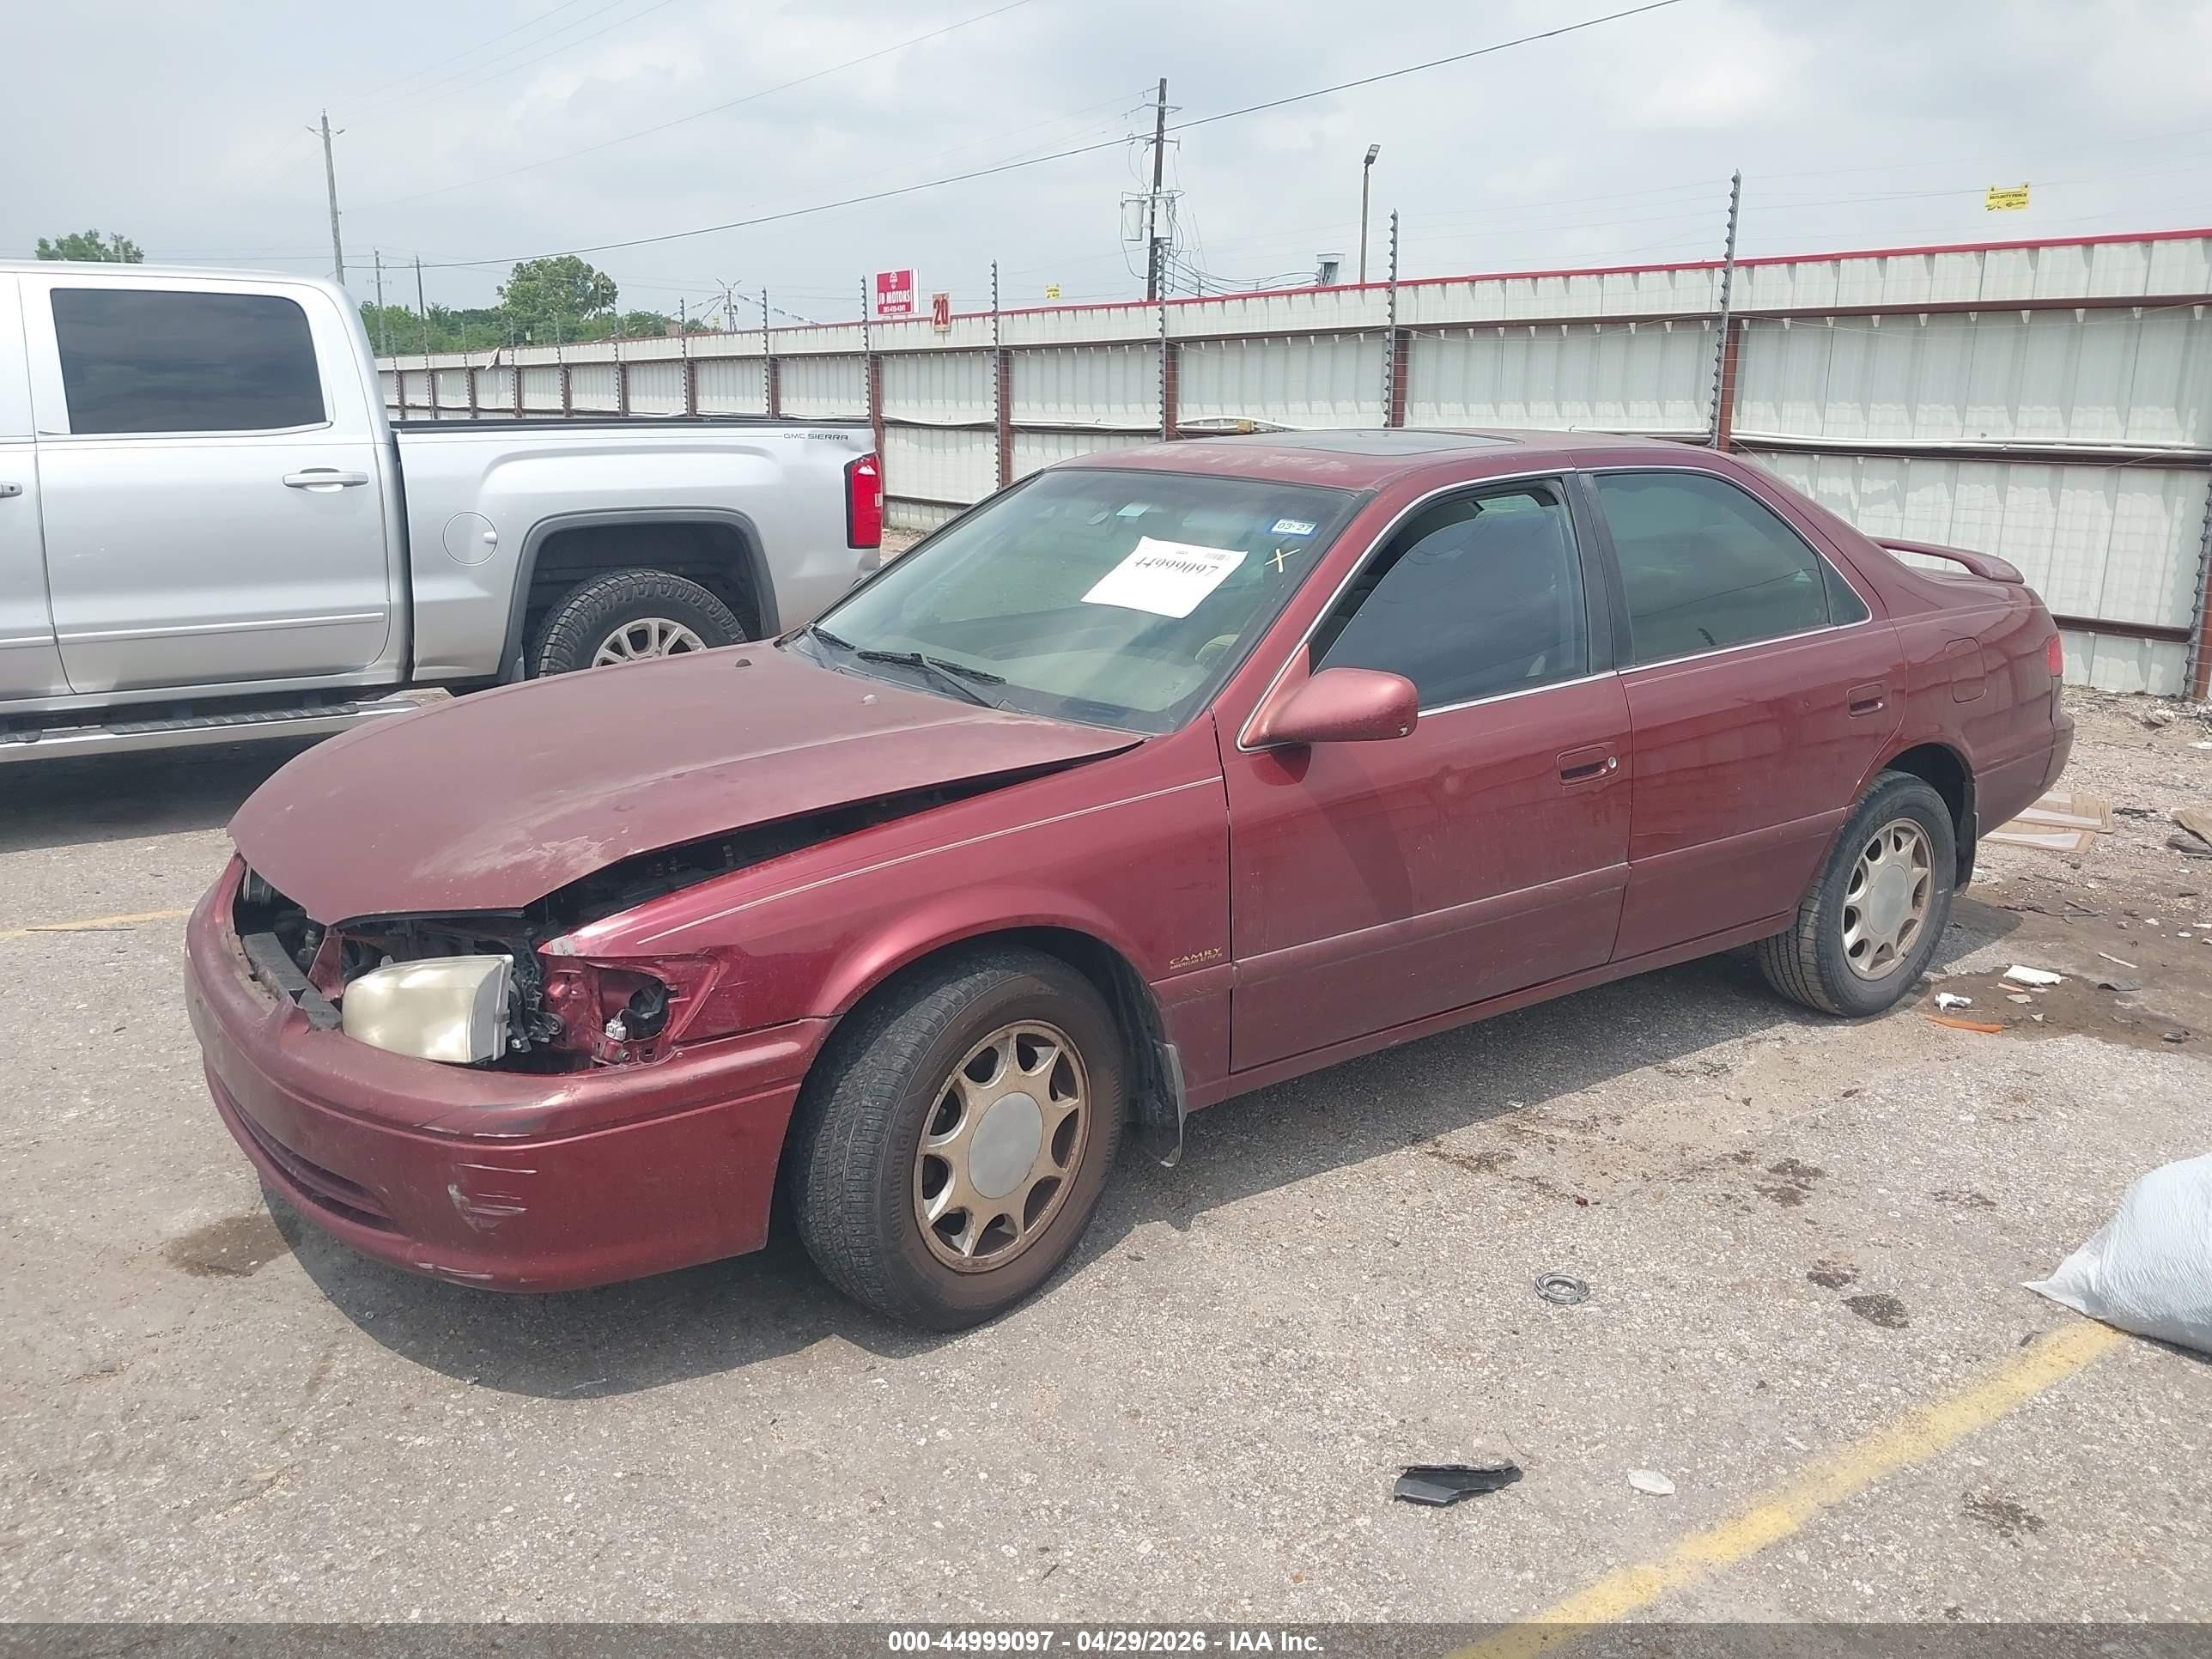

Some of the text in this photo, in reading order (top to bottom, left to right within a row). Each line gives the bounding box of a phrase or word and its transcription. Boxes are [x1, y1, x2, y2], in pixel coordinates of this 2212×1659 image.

[886, 289, 910, 304] MOTORS
[933, 298, 949, 325] 20
[1134, 556, 1219, 577] 44999097
[1170, 947, 1222, 964] CAMRY
